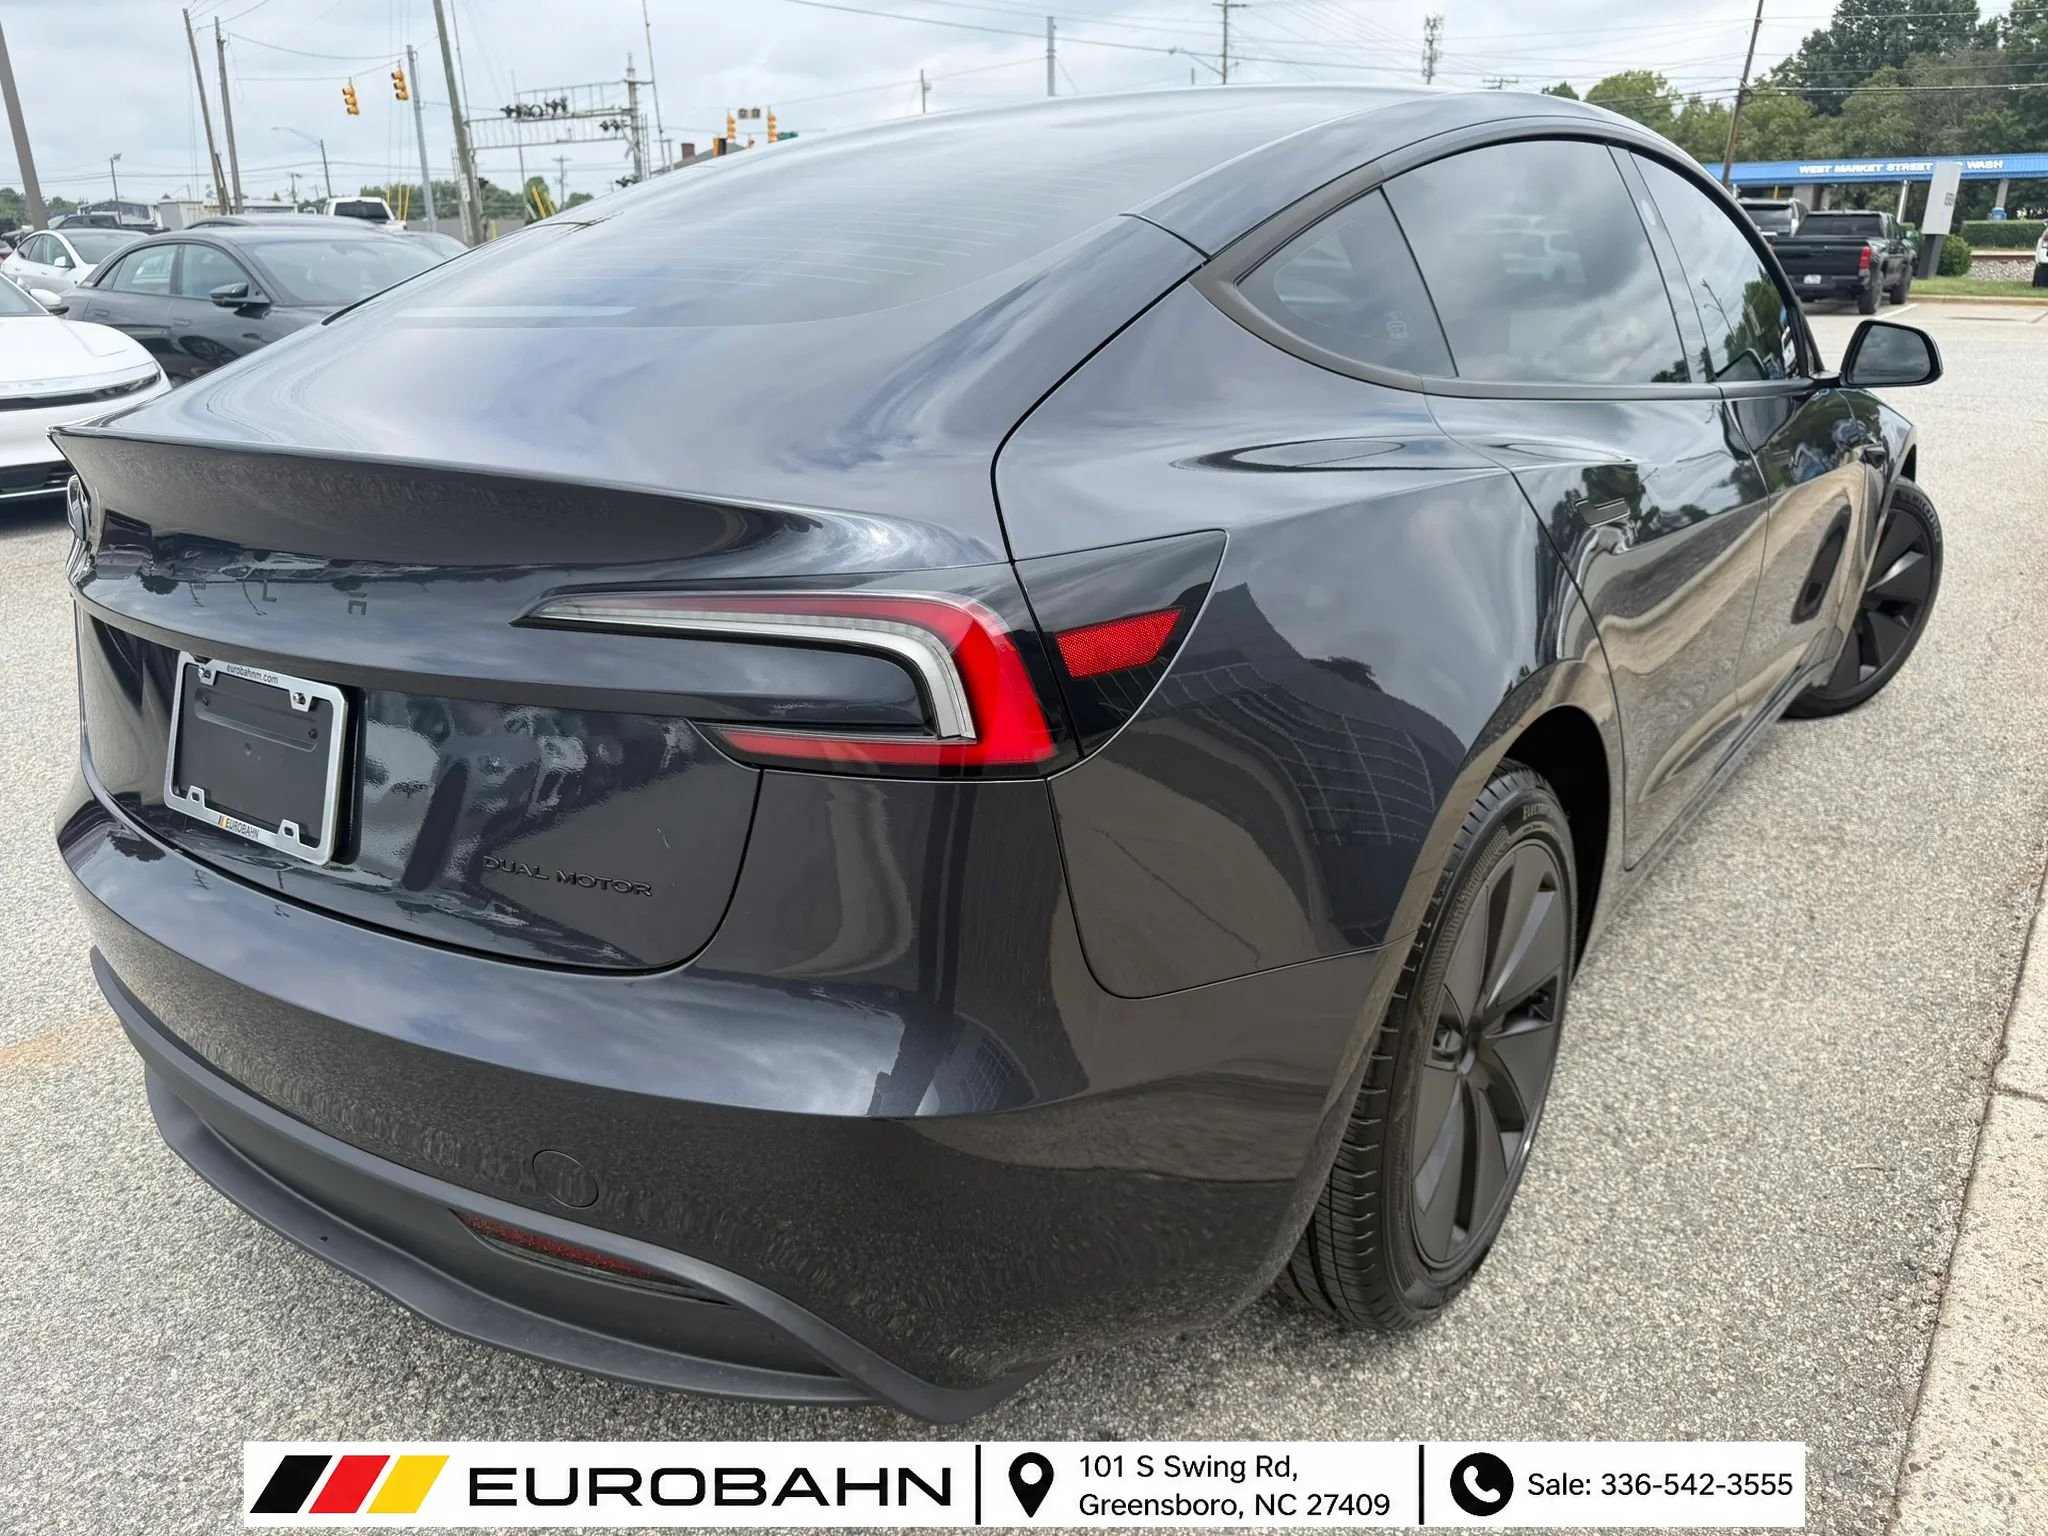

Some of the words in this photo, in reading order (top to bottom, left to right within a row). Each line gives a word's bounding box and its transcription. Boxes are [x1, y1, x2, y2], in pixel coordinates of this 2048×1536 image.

[1798, 164, 1832, 175] WEST
[1833, 163, 1885, 174] MARKET
[1885, 161, 1934, 172] STREET
[1966, 158, 2004, 170] WASH
[225, 818, 261, 841] EUROBAHN
[483, 855, 549, 880] DUAL
[555, 869, 653, 897] MOTOR
